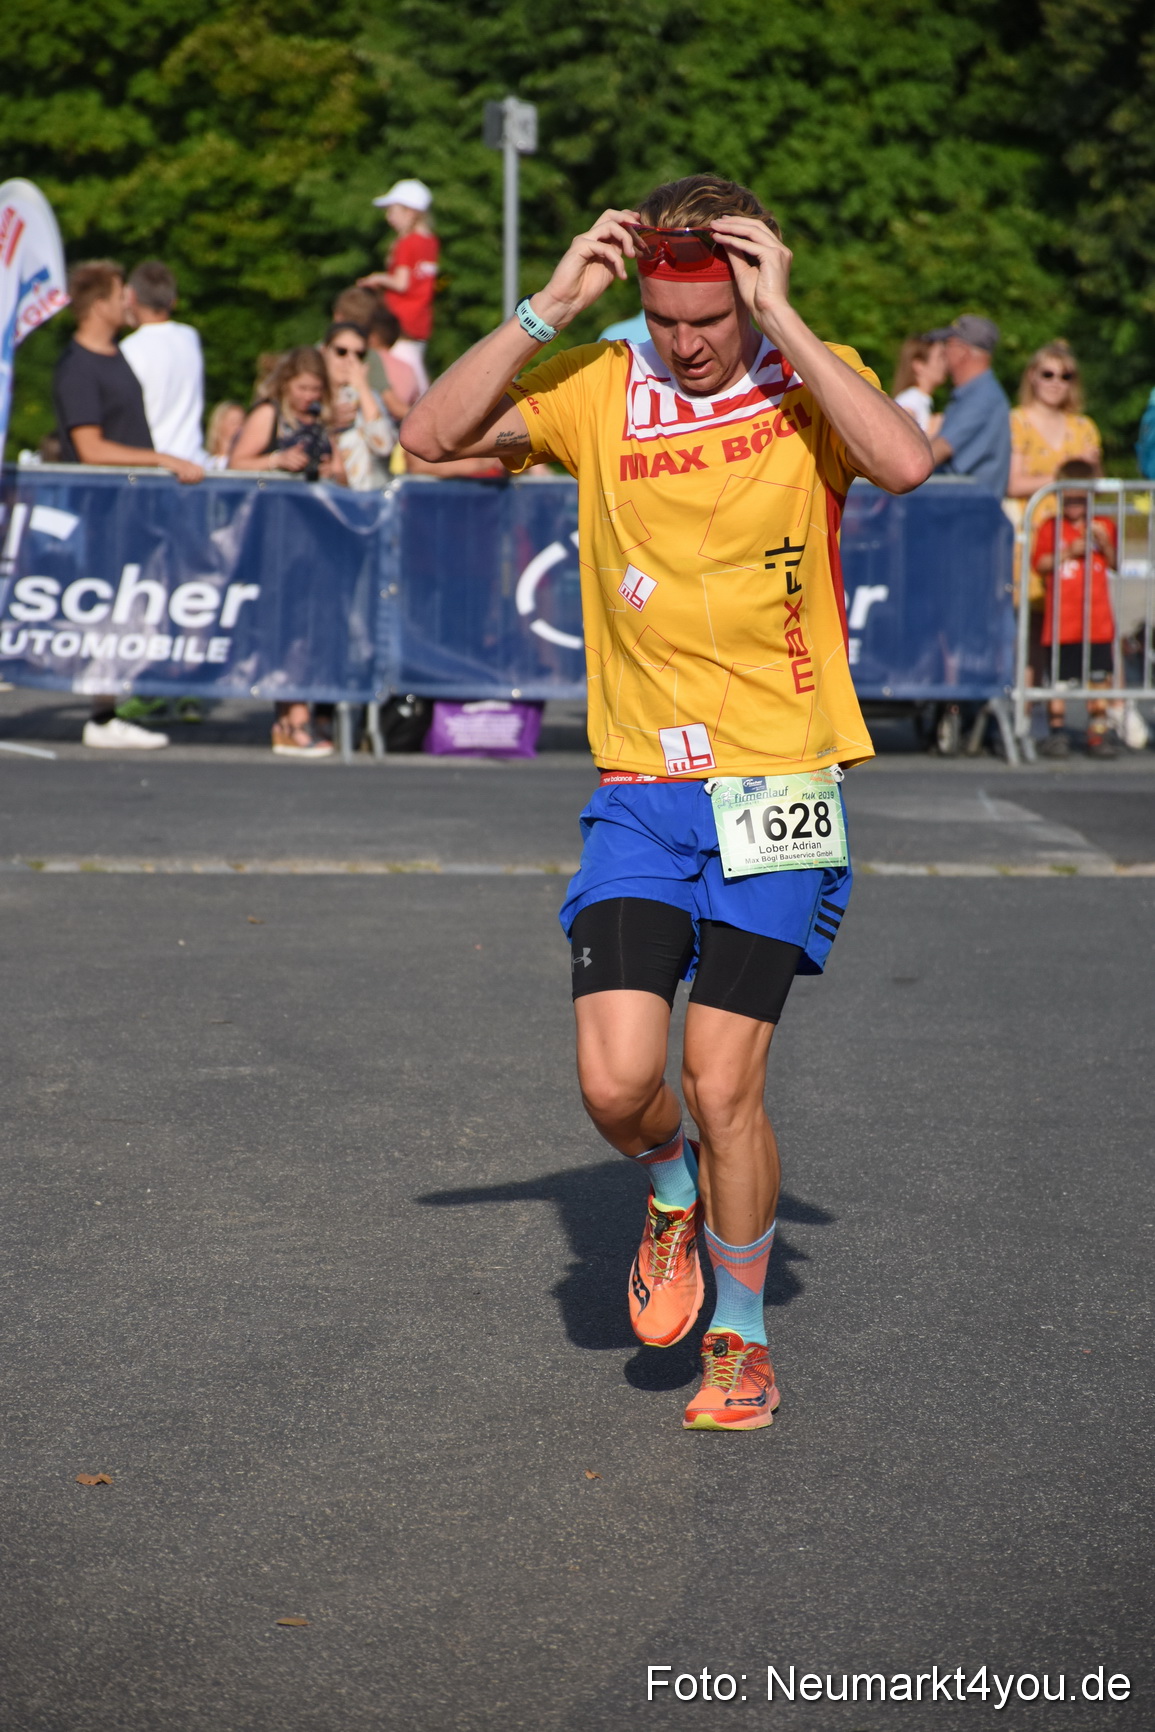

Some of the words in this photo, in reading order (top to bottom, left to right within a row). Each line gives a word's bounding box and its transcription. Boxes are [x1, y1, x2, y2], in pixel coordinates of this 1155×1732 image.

[619, 445, 709, 481] MAX
[721, 402, 812, 464] BÖGL
[611, 775, 633, 783] balance
[734, 786, 789, 804] firmenlauf
[818, 791, 835, 800] 2019
[735, 800, 832, 845] 1628
[759, 844, 789, 855] Lober
[792, 841, 822, 851] Adrian
[745, 857, 760, 865] Max
[780, 852, 815, 861] Bauservice
[816, 850, 833, 858] GmbH
